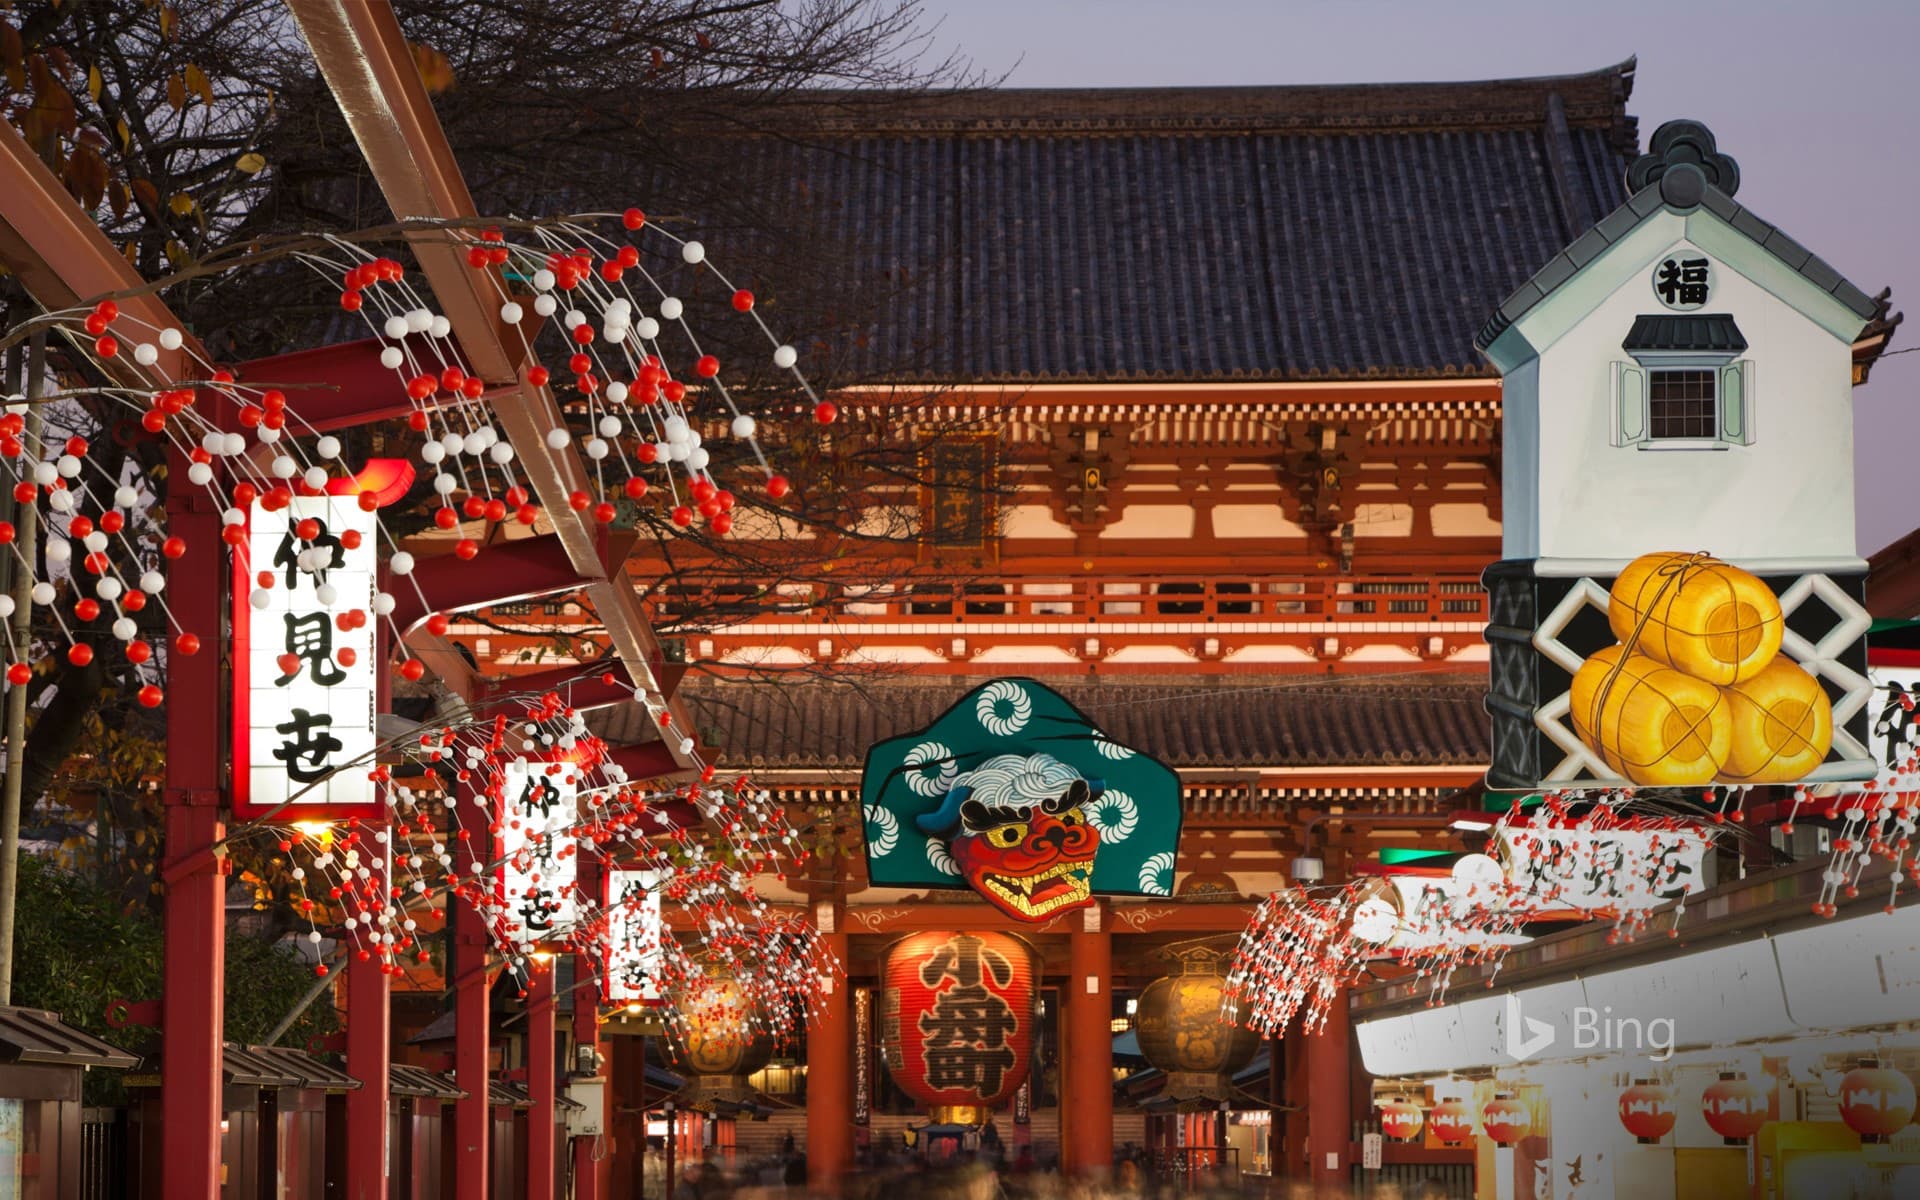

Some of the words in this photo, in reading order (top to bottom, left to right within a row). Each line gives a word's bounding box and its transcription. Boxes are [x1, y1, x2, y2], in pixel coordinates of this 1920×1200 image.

[1658, 258, 1709, 304] 福
[273, 516, 347, 784] 仲見世
